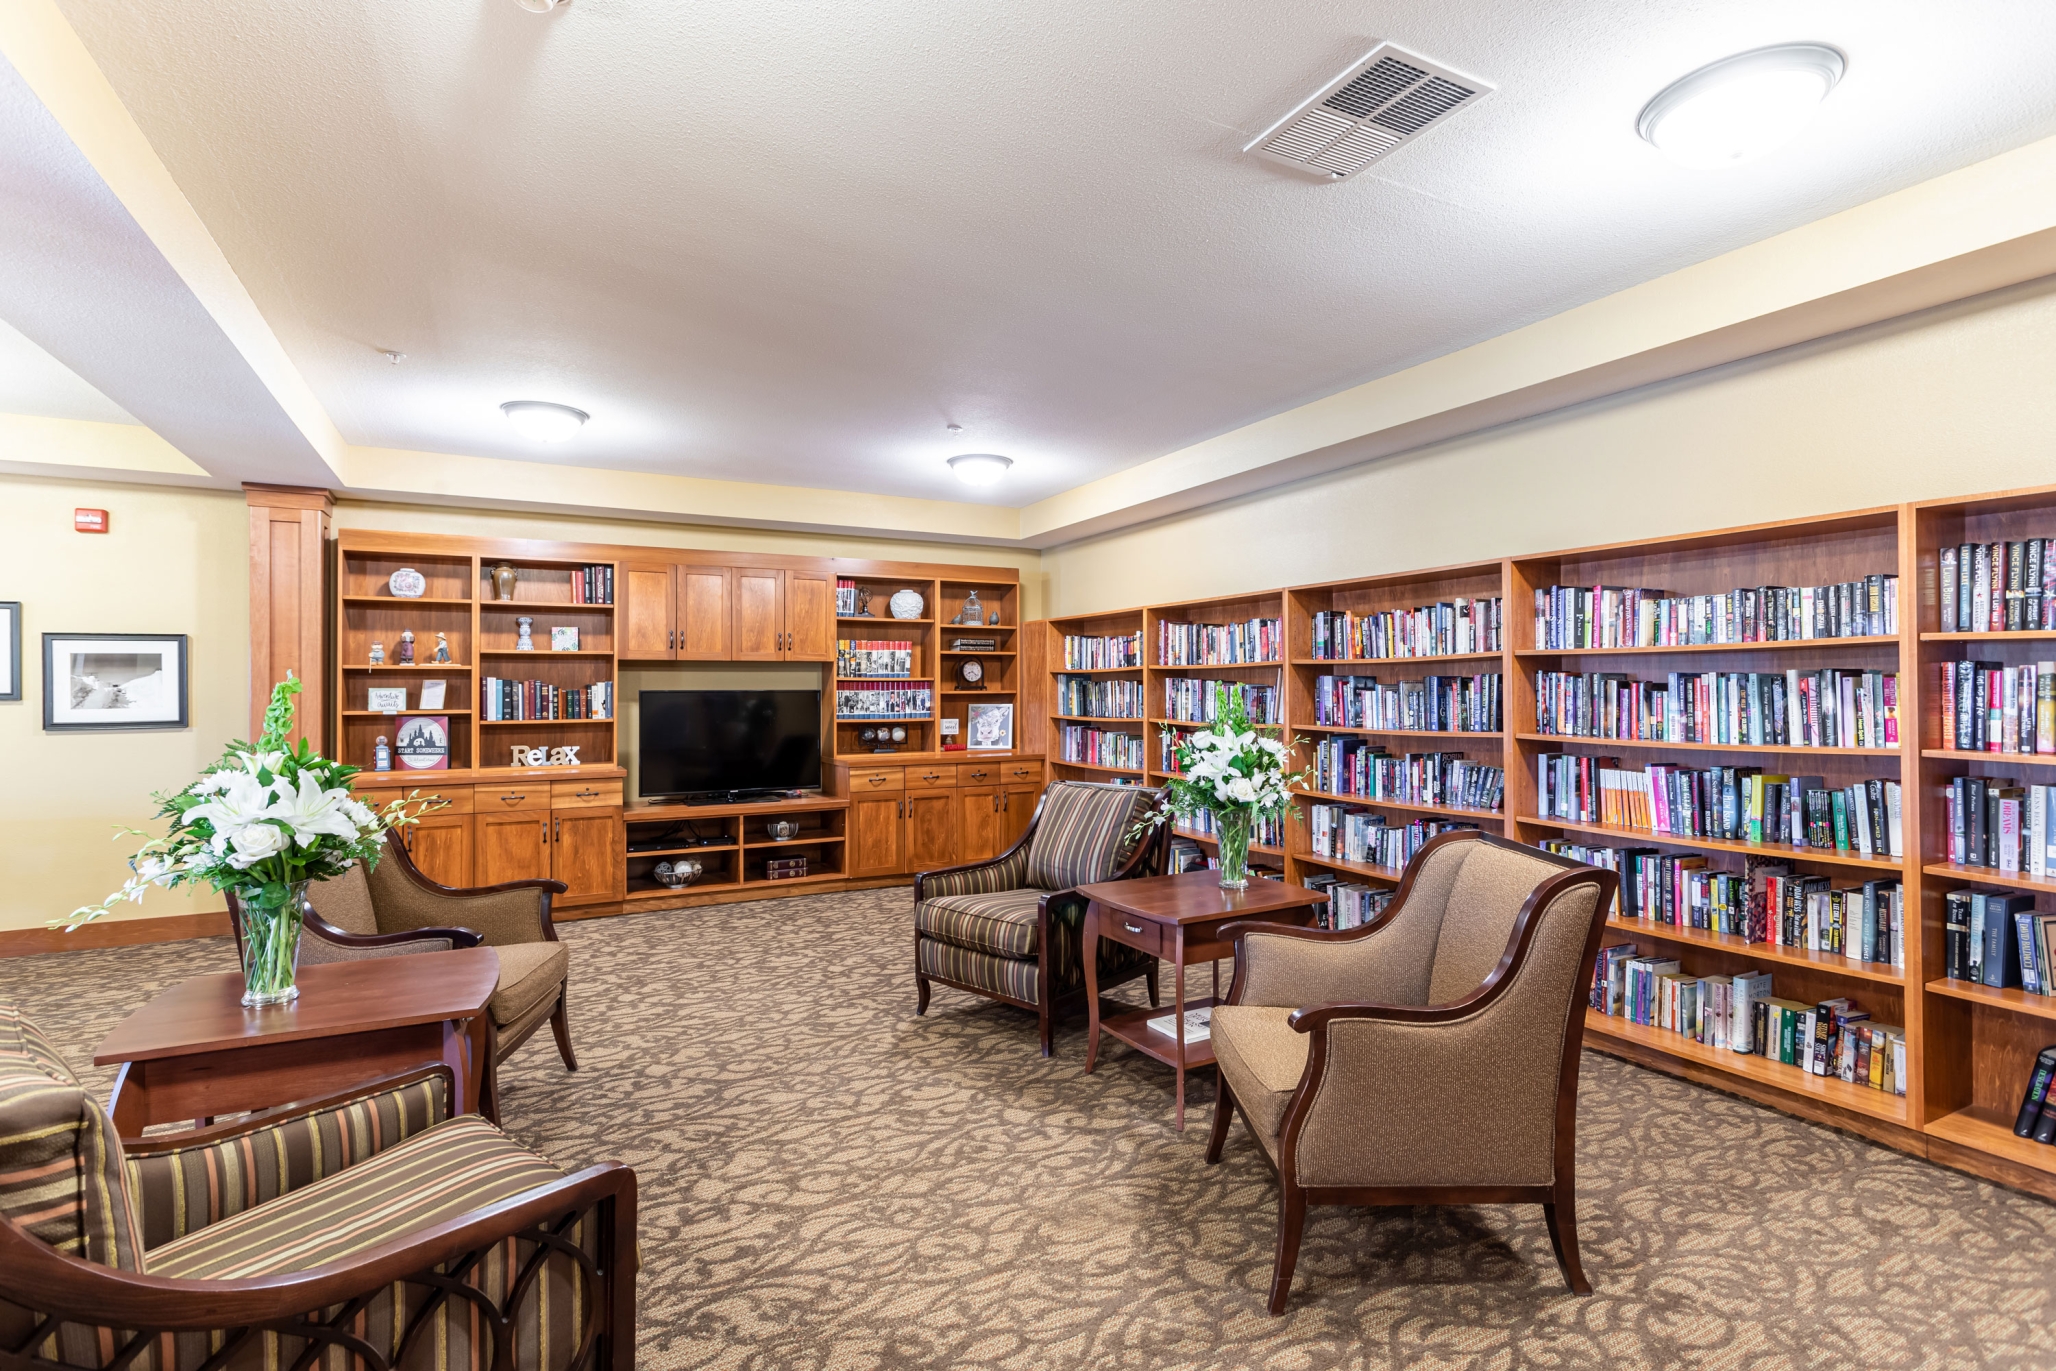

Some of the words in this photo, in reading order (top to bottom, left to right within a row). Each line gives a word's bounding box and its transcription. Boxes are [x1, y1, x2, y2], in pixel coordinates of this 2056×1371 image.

[1975, 548, 1983, 570] VINCE
[2011, 545, 2020, 567] VINCE
[2028, 541, 2037, 564] VINCE
[1943, 567, 1954, 586] LAURA
[2011, 568, 2019, 589] FLYNN
[2028, 564, 2037, 587] FLYNN
[1943, 588, 1954, 604] BUSH
[1944, 716, 1953, 740] EXPOSED
[1442, 753, 1463, 761] ROBIN
[1722, 795, 1734, 809] PLUM
[1723, 811, 1734, 830] ISLAND
[2003, 802, 2012, 835] DREAMS
[1794, 886, 1802, 899] JOAN
[1804, 883, 1817, 894] JOAN
[1817, 881, 1831, 892] HESS
[1794, 899, 1802, 913] HESS
[2019, 924, 2031, 940] DAVID
[2022, 941, 2033, 968] BALDACCI
[1749, 989, 1771, 999] MORTON
[1753, 982, 1766, 990] KATE
[1815, 1021, 1823, 1039] WOODS
[2031, 1069, 2047, 1101] DESECRATION
